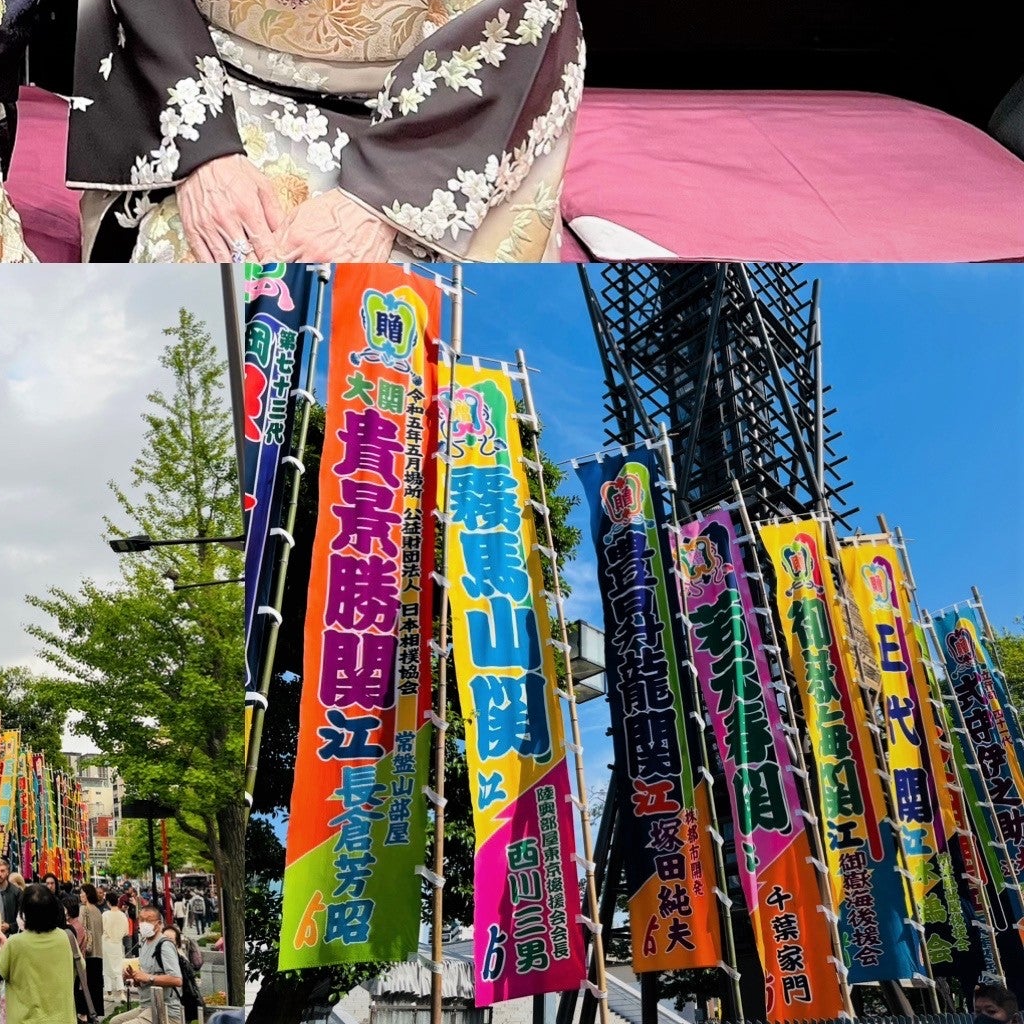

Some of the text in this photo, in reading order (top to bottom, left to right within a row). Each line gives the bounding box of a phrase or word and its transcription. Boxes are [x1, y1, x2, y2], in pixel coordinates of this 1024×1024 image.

[264, 328, 298, 445] 第七十三代
[376, 311, 403, 344] 贈
[341, 371, 406, 415] 大関
[396, 387, 426, 696] 令和五年五月場所 公益財団法人 日本相撲協会
[383, 730, 417, 846] 常盤山部屋
[323, 764, 388, 945] 長倉芳昭
[506, 836, 551, 976] 西川三男
[534, 785, 572, 960] 陸奥部屋東京後援会会長
[645, 817, 697, 954] 塚田純夫
[839, 852, 884, 967] 御嶽海後援会
[766, 886, 814, 1006] 千葉家門
